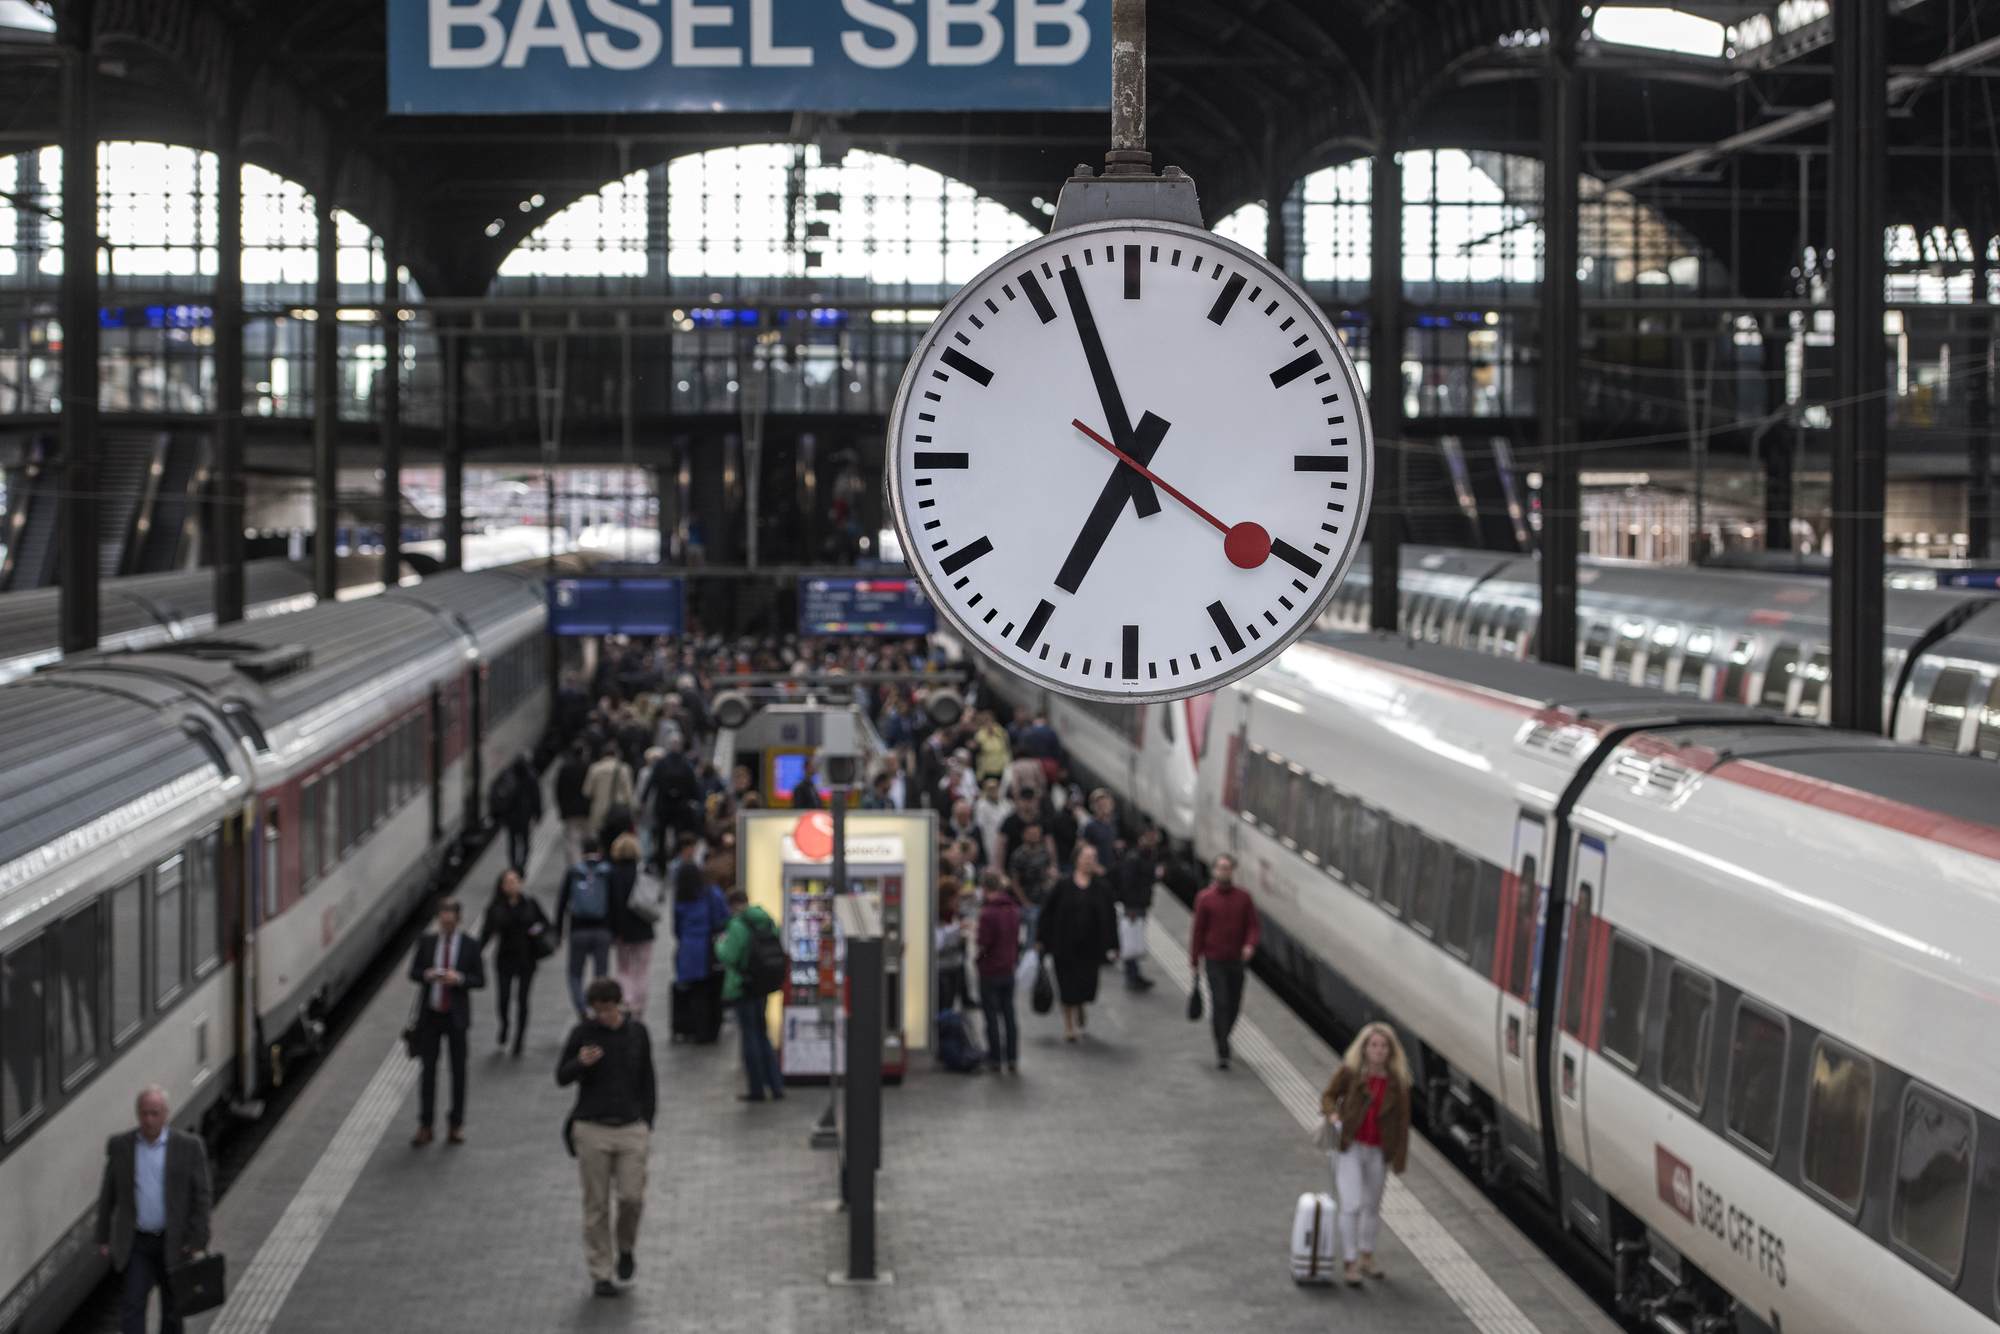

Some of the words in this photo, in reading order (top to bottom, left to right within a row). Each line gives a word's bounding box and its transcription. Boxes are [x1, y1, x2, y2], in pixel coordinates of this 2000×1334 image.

[428, 0, 815, 70] BASEL
[840, 0, 1092, 69] SBB
[1697, 1180, 1725, 1240] SBB
[1727, 1204, 1754, 1262] CFF
[1758, 1225, 1787, 1290] FFS
